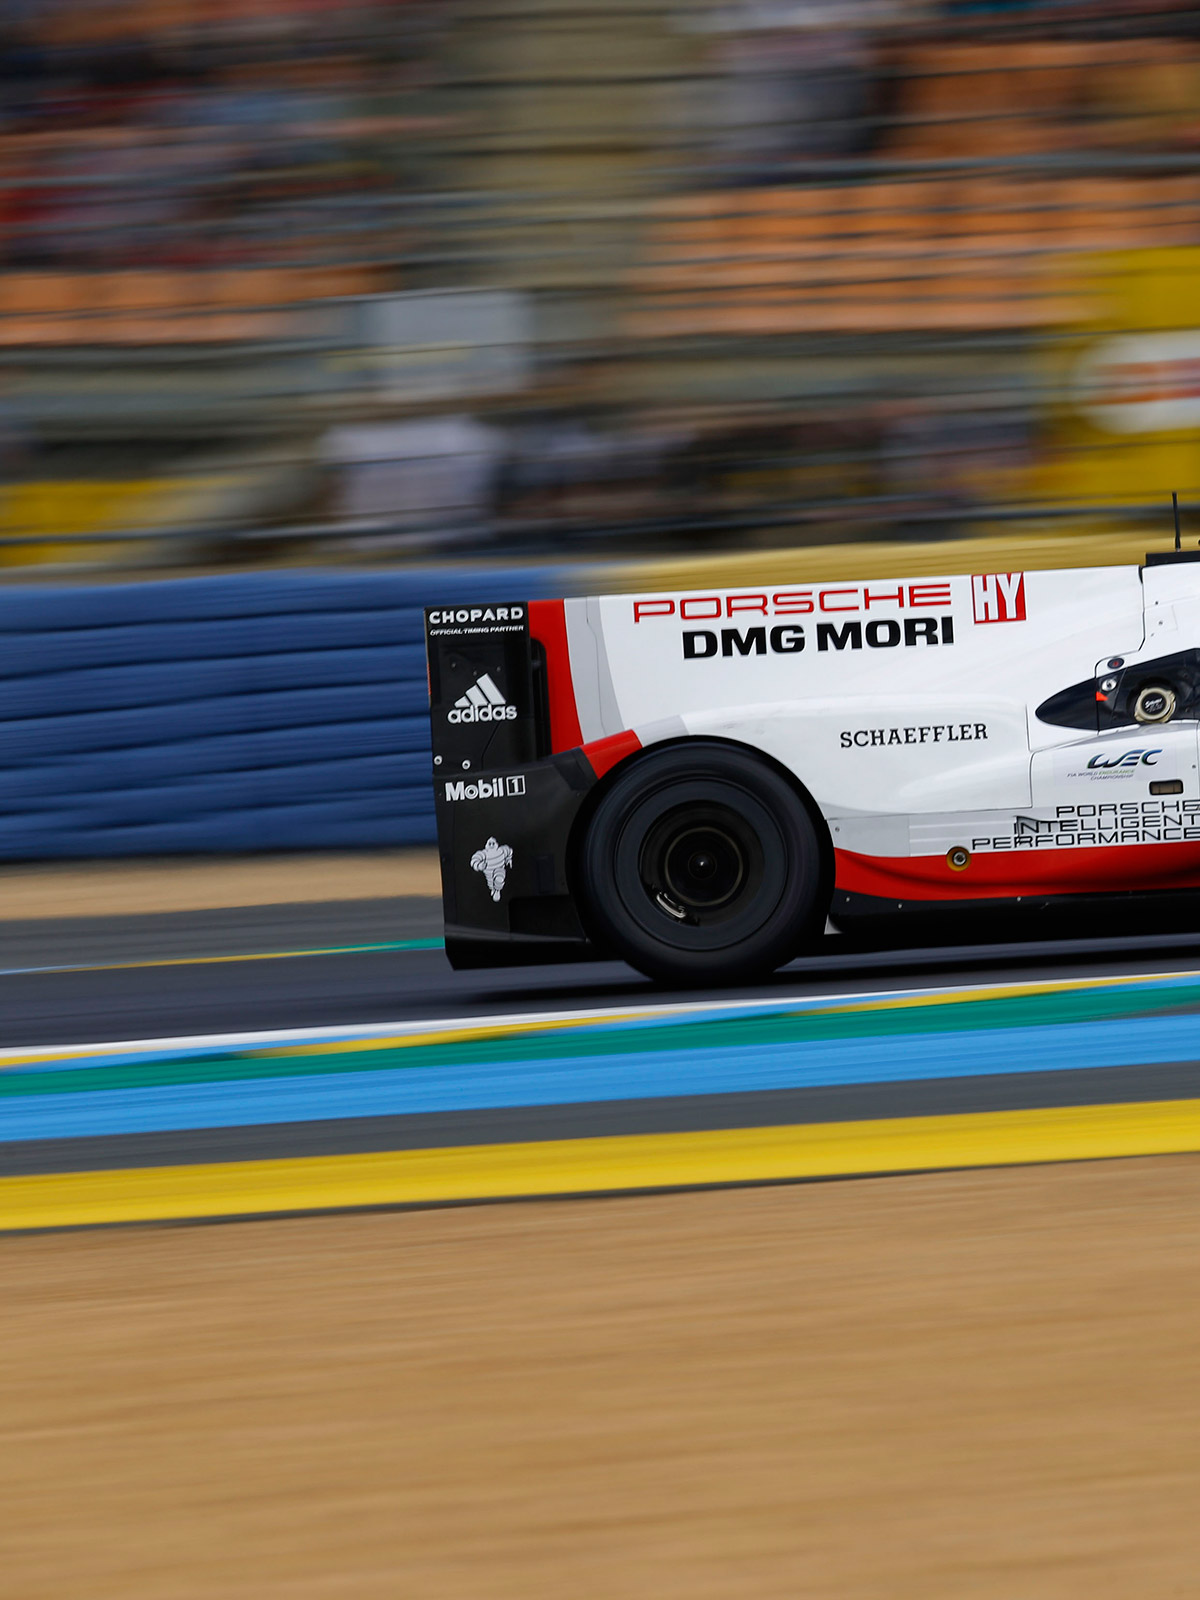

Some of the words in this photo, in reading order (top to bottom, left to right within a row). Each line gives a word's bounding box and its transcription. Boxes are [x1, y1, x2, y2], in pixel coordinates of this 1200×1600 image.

[634, 583, 952, 623] PORSCHE
[974, 572, 1022, 623] HY
[428, 607, 524, 625] CHOPARD
[430, 627, 463, 637] OFFICIAL
[463, 625, 489, 634] TIMING
[490, 624, 525, 633] PARTNER
[682, 625, 806, 660] DMG
[816, 616, 955, 652] MORI
[447, 703, 518, 724] adidas
[840, 723, 988, 748] SCHAEFFLER
[1086, 749, 1163, 769] WEC
[444, 777, 504, 801] Mobil
